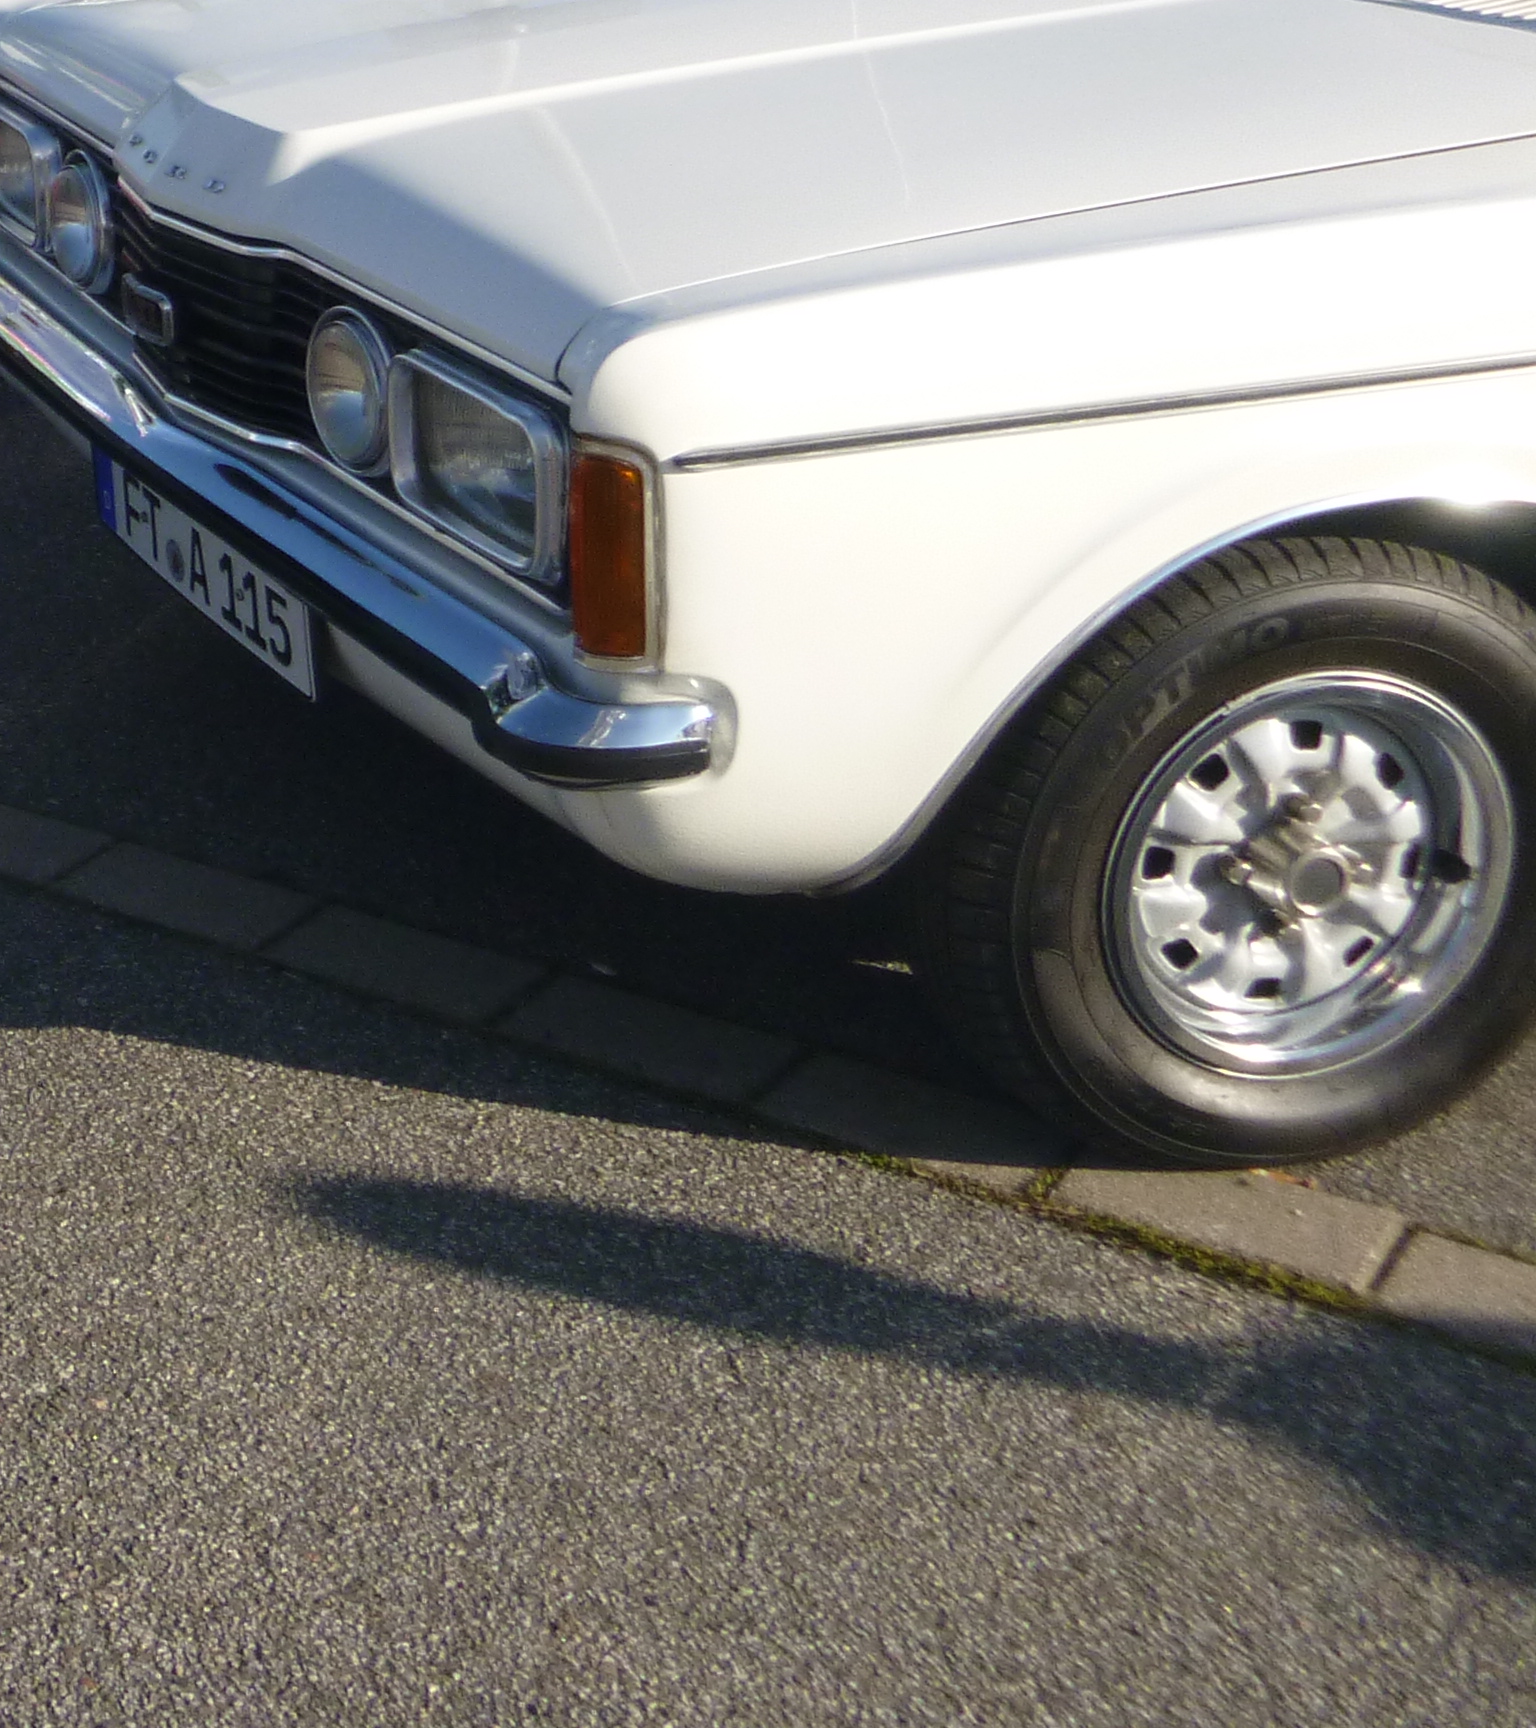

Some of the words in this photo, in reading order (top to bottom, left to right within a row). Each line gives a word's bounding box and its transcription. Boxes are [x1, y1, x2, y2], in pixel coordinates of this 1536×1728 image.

[123, 471, 161, 562] FT
[190, 526, 211, 607] A
[219, 552, 293, 667] 115
